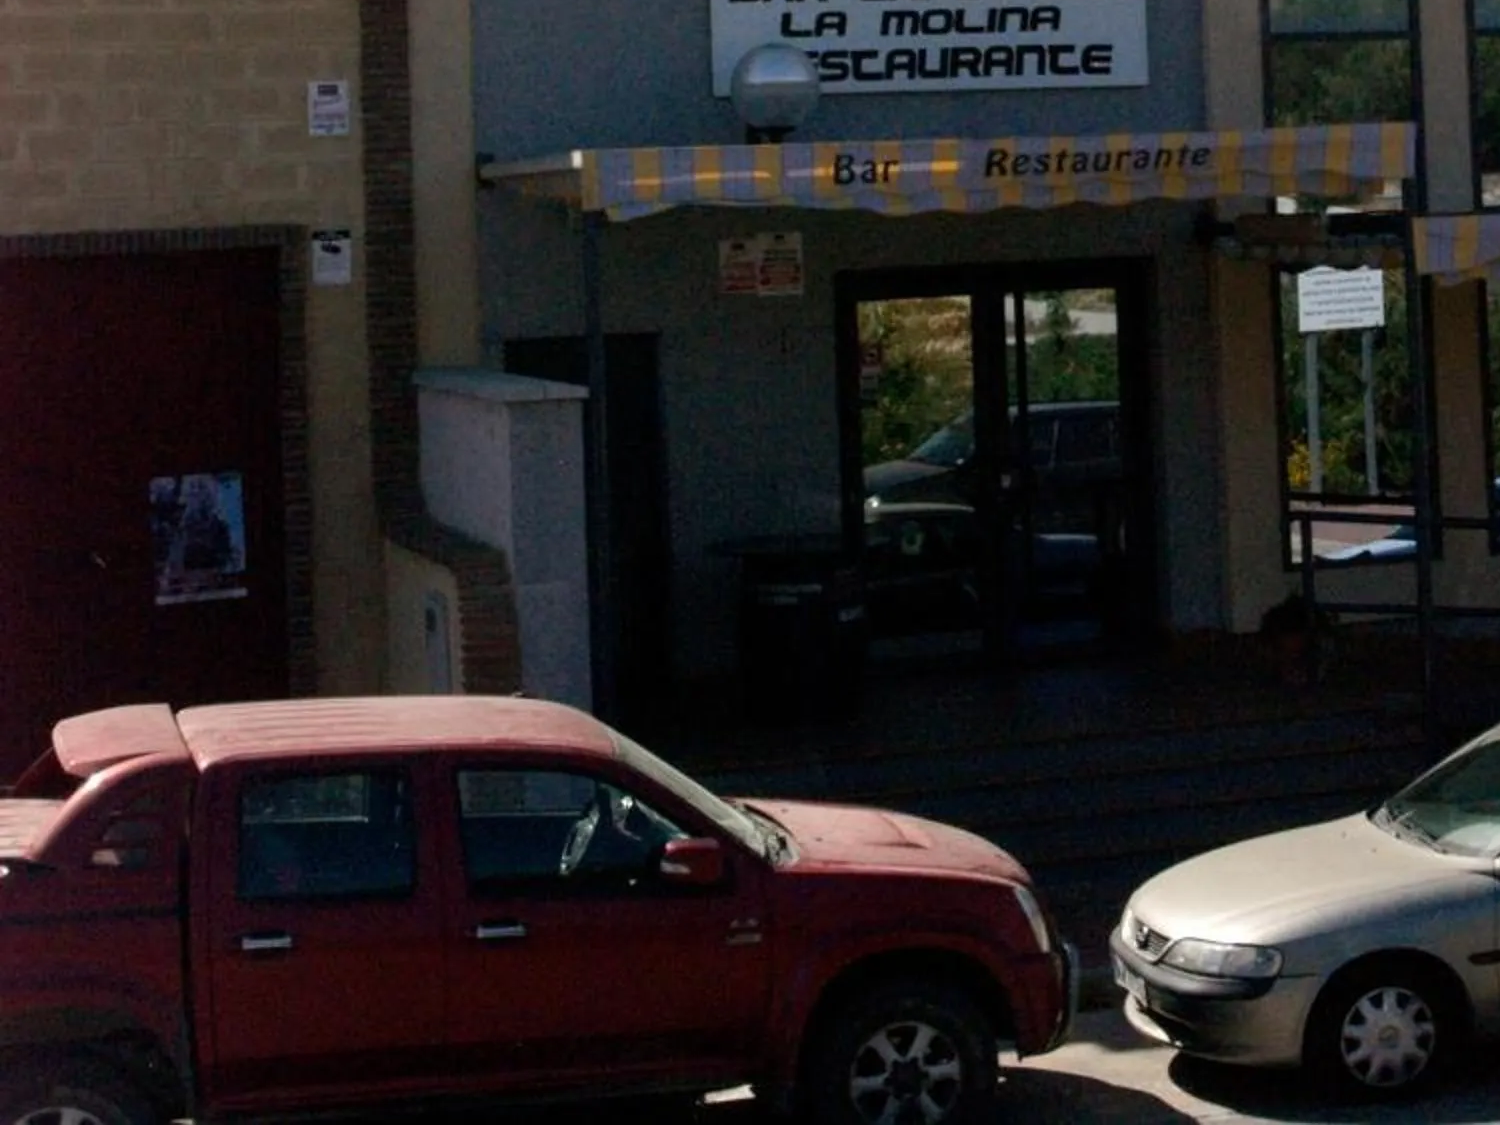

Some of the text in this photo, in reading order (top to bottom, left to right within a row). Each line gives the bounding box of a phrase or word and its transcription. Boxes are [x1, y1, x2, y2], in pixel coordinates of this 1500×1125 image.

[780, 5, 1062, 38] LA MOLINA
[804, 43, 1114, 83] STAURANTE
[832, 142, 1213, 186] Bar Restaurante
